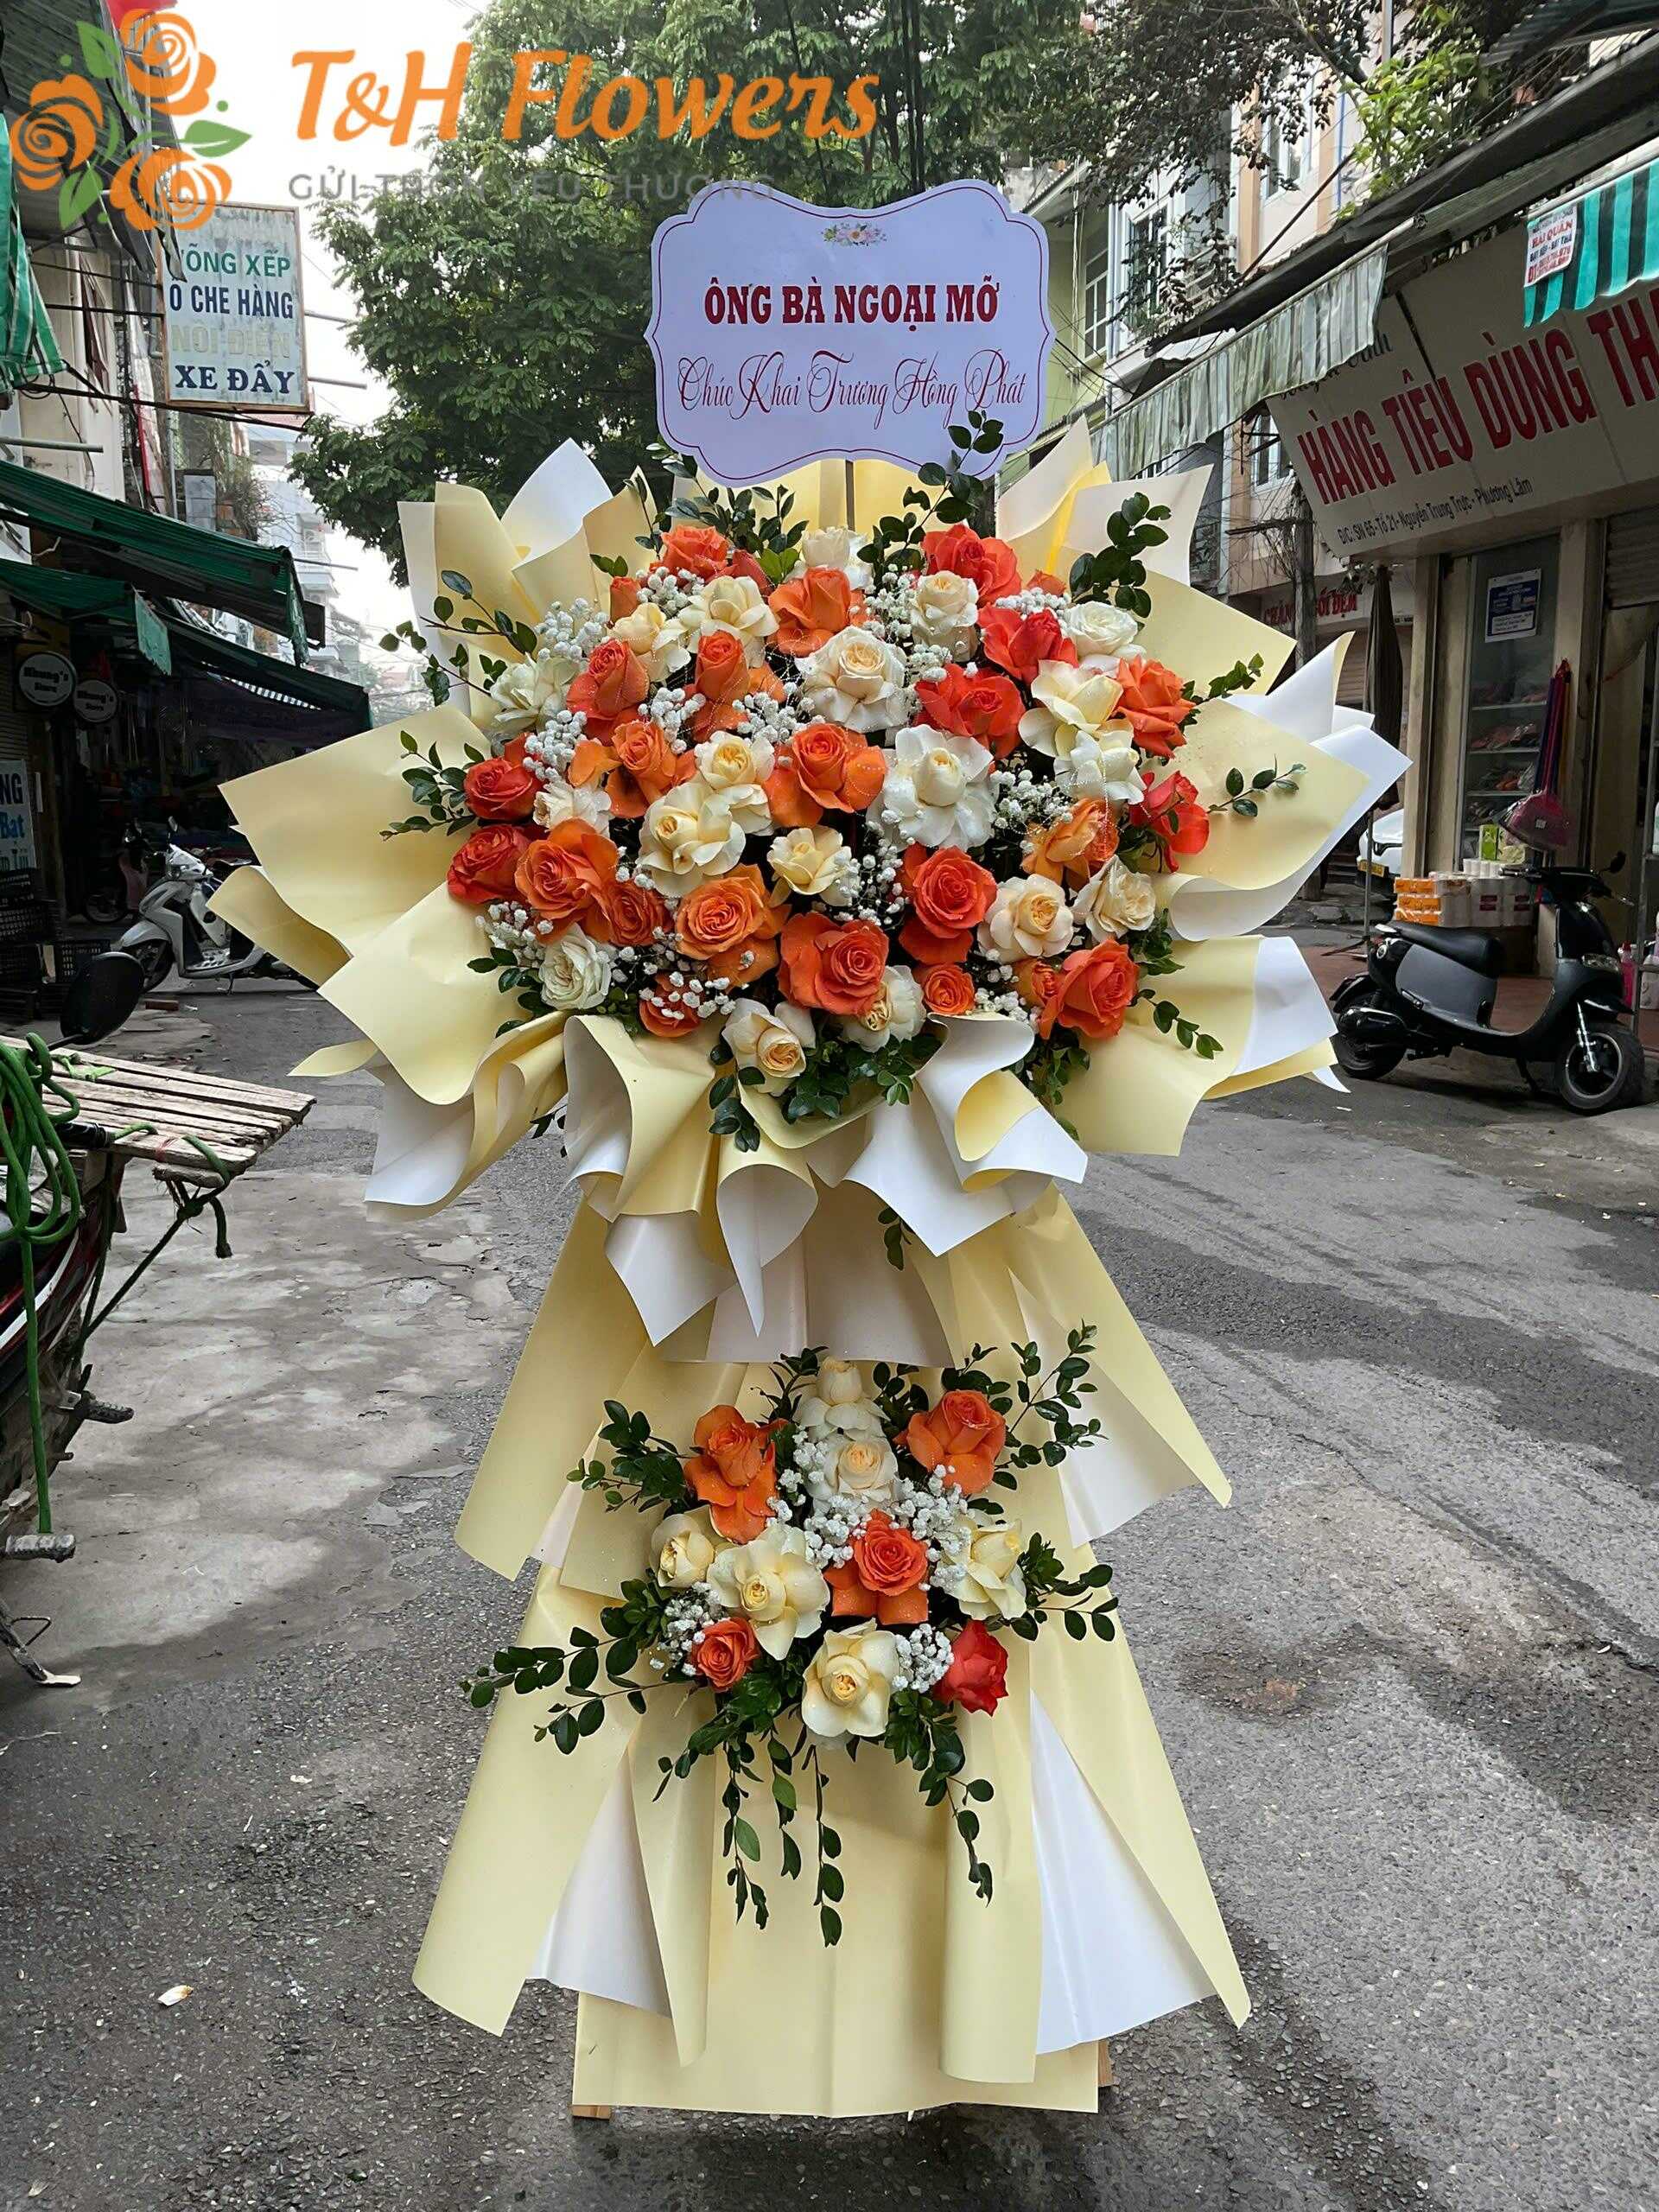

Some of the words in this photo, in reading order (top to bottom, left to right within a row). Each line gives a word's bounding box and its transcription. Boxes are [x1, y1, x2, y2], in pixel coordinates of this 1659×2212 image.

[181, 243, 237, 275] ÕNG
[191, 285, 230, 314] CHE
[238, 283, 293, 319] HÀNG
[704, 276, 772, 325] ÔNG
[782, 276, 825, 323] BÀ
[834, 284, 936, 332] NGOẠI
[946, 276, 1001, 323] MỠ
[175, 365, 219, 391] XE
[227, 359, 295, 394] ĐẨY
[677, 356, 734, 410] Chúc
[728, 351, 801, 421] Khai
[807, 350, 889, 429] Trương
[893, 351, 958, 429] Hồng
[964, 349, 1027, 413] Phát
[1297, 409, 1396, 505] HÀNG
[1382, 368, 1473, 475] TIÊU
[1464, 328, 1597, 449] DÙNG
[1586, 288, 1659, 407] TH
